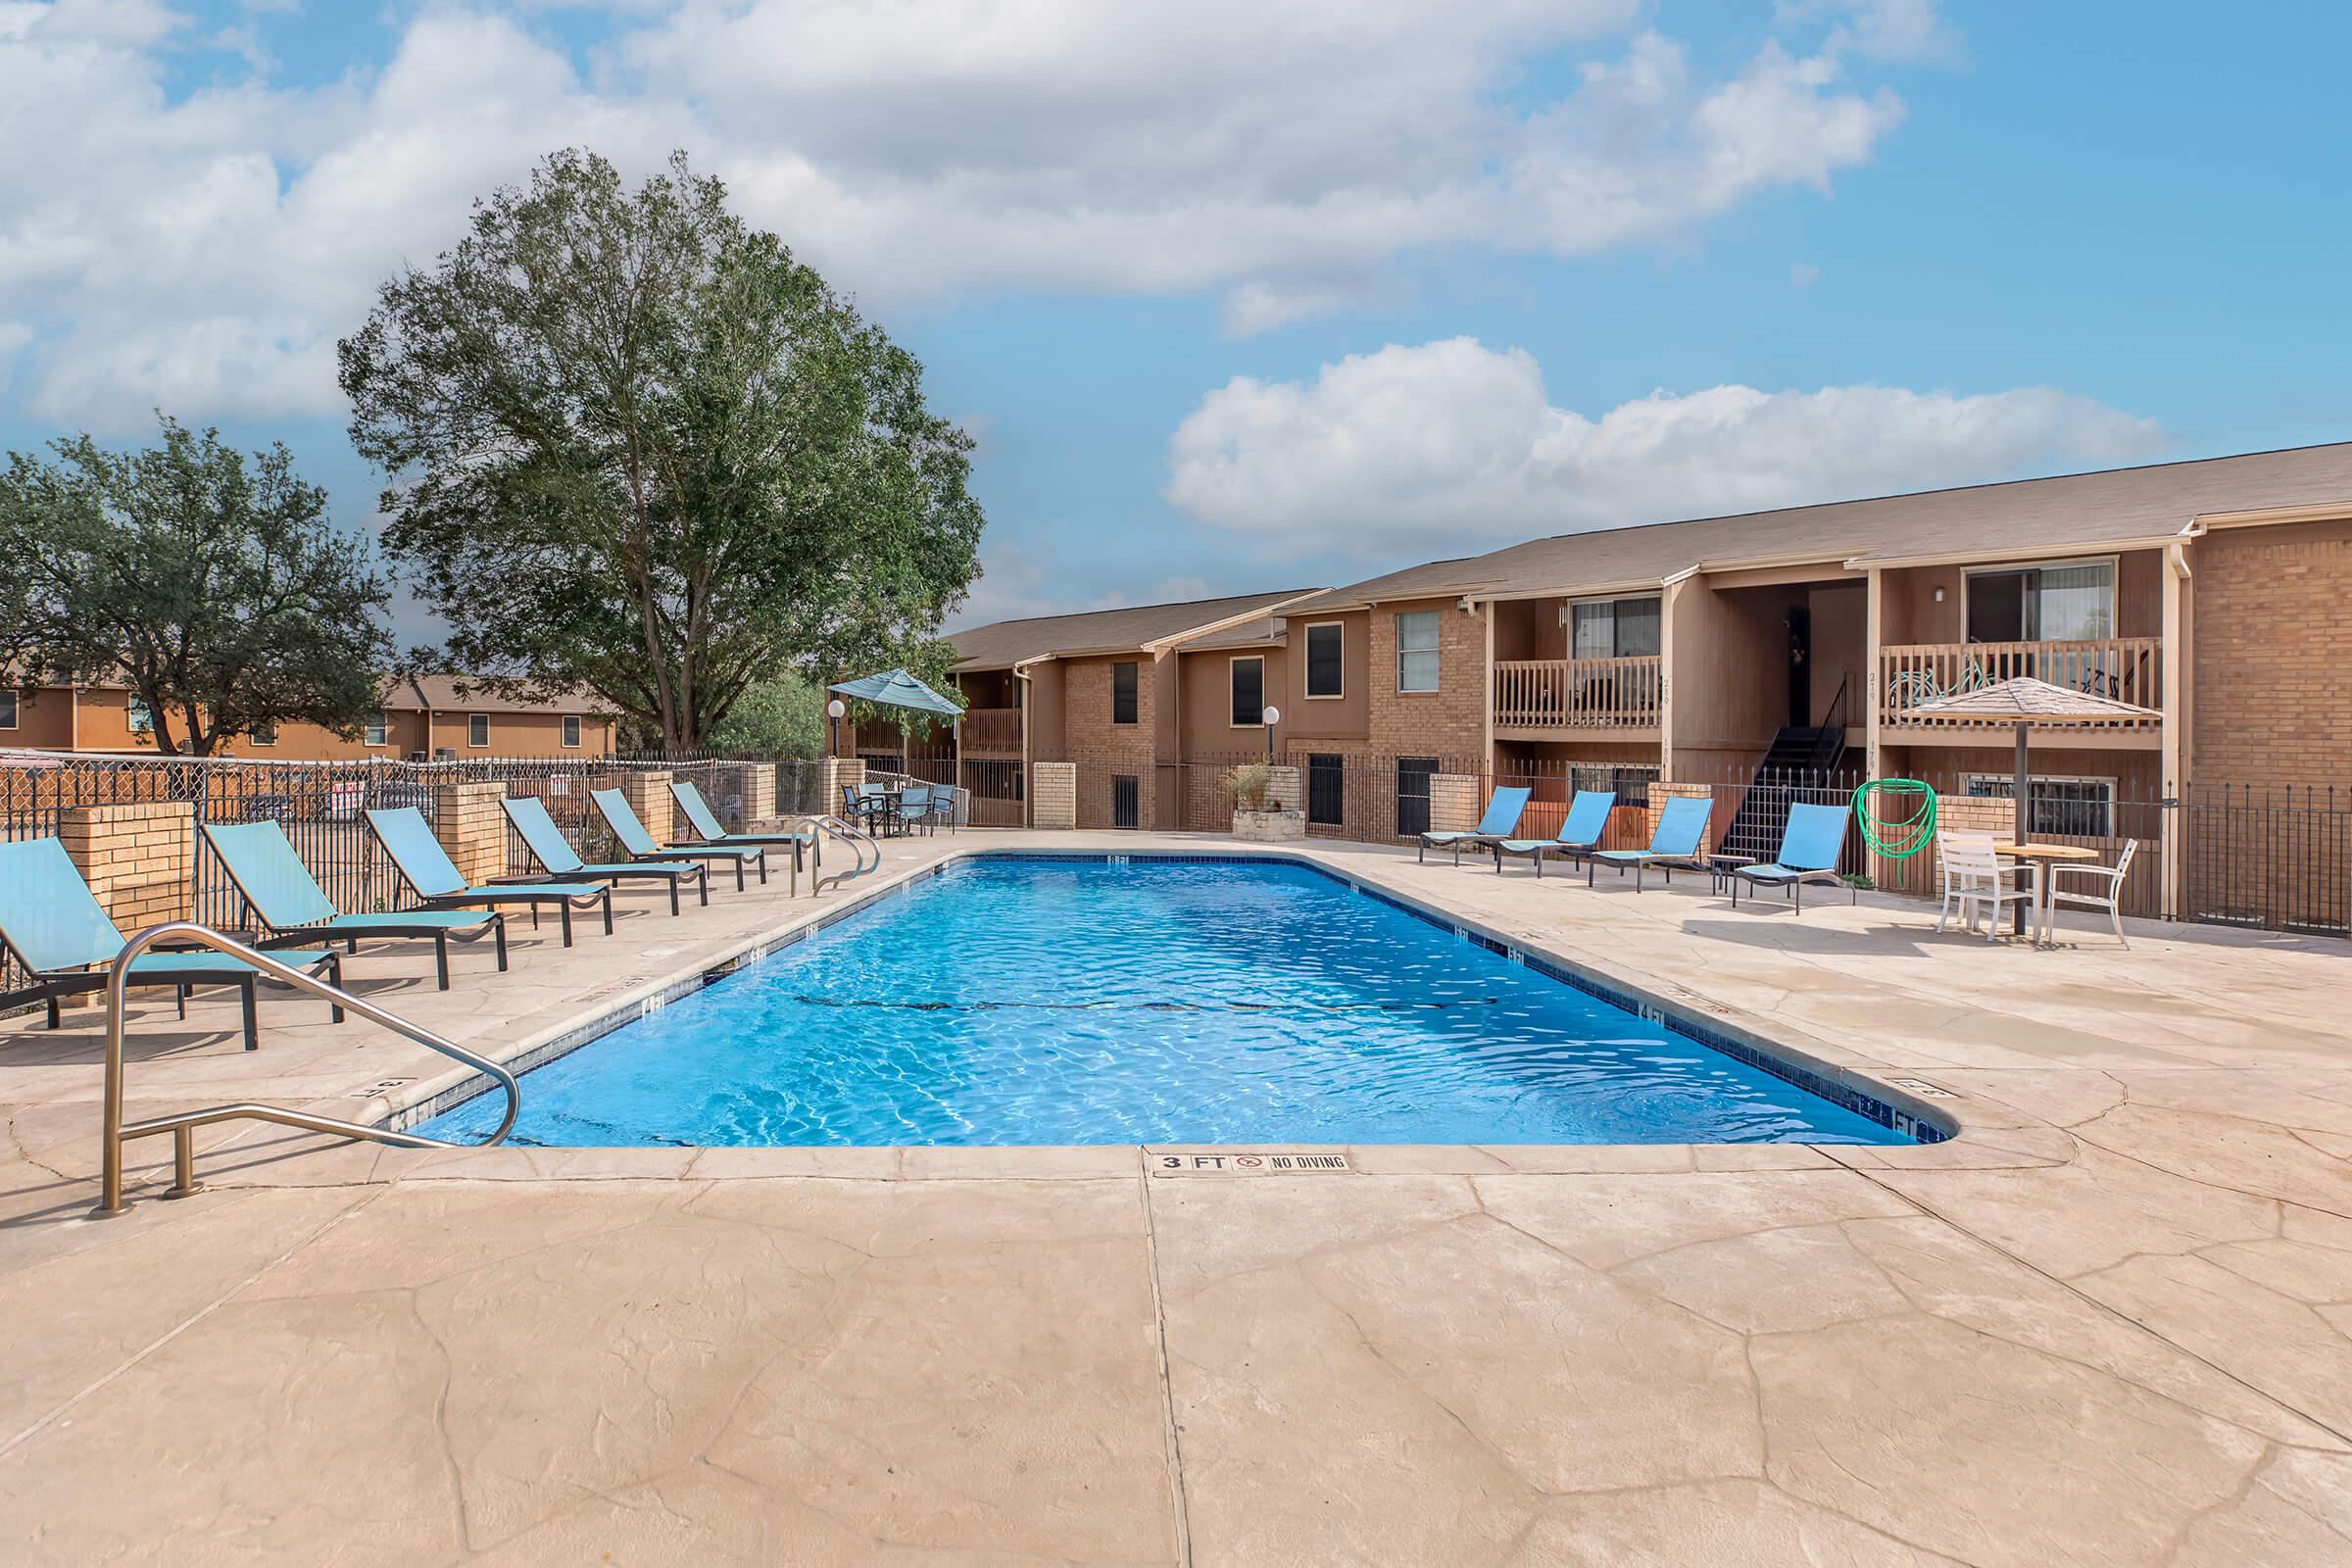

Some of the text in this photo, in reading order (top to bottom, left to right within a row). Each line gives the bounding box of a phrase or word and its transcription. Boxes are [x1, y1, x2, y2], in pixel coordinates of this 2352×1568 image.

[1895, 1109, 1915, 1137] FT
[1162, 1156, 1346, 1169] 3 FT NO DIVING
